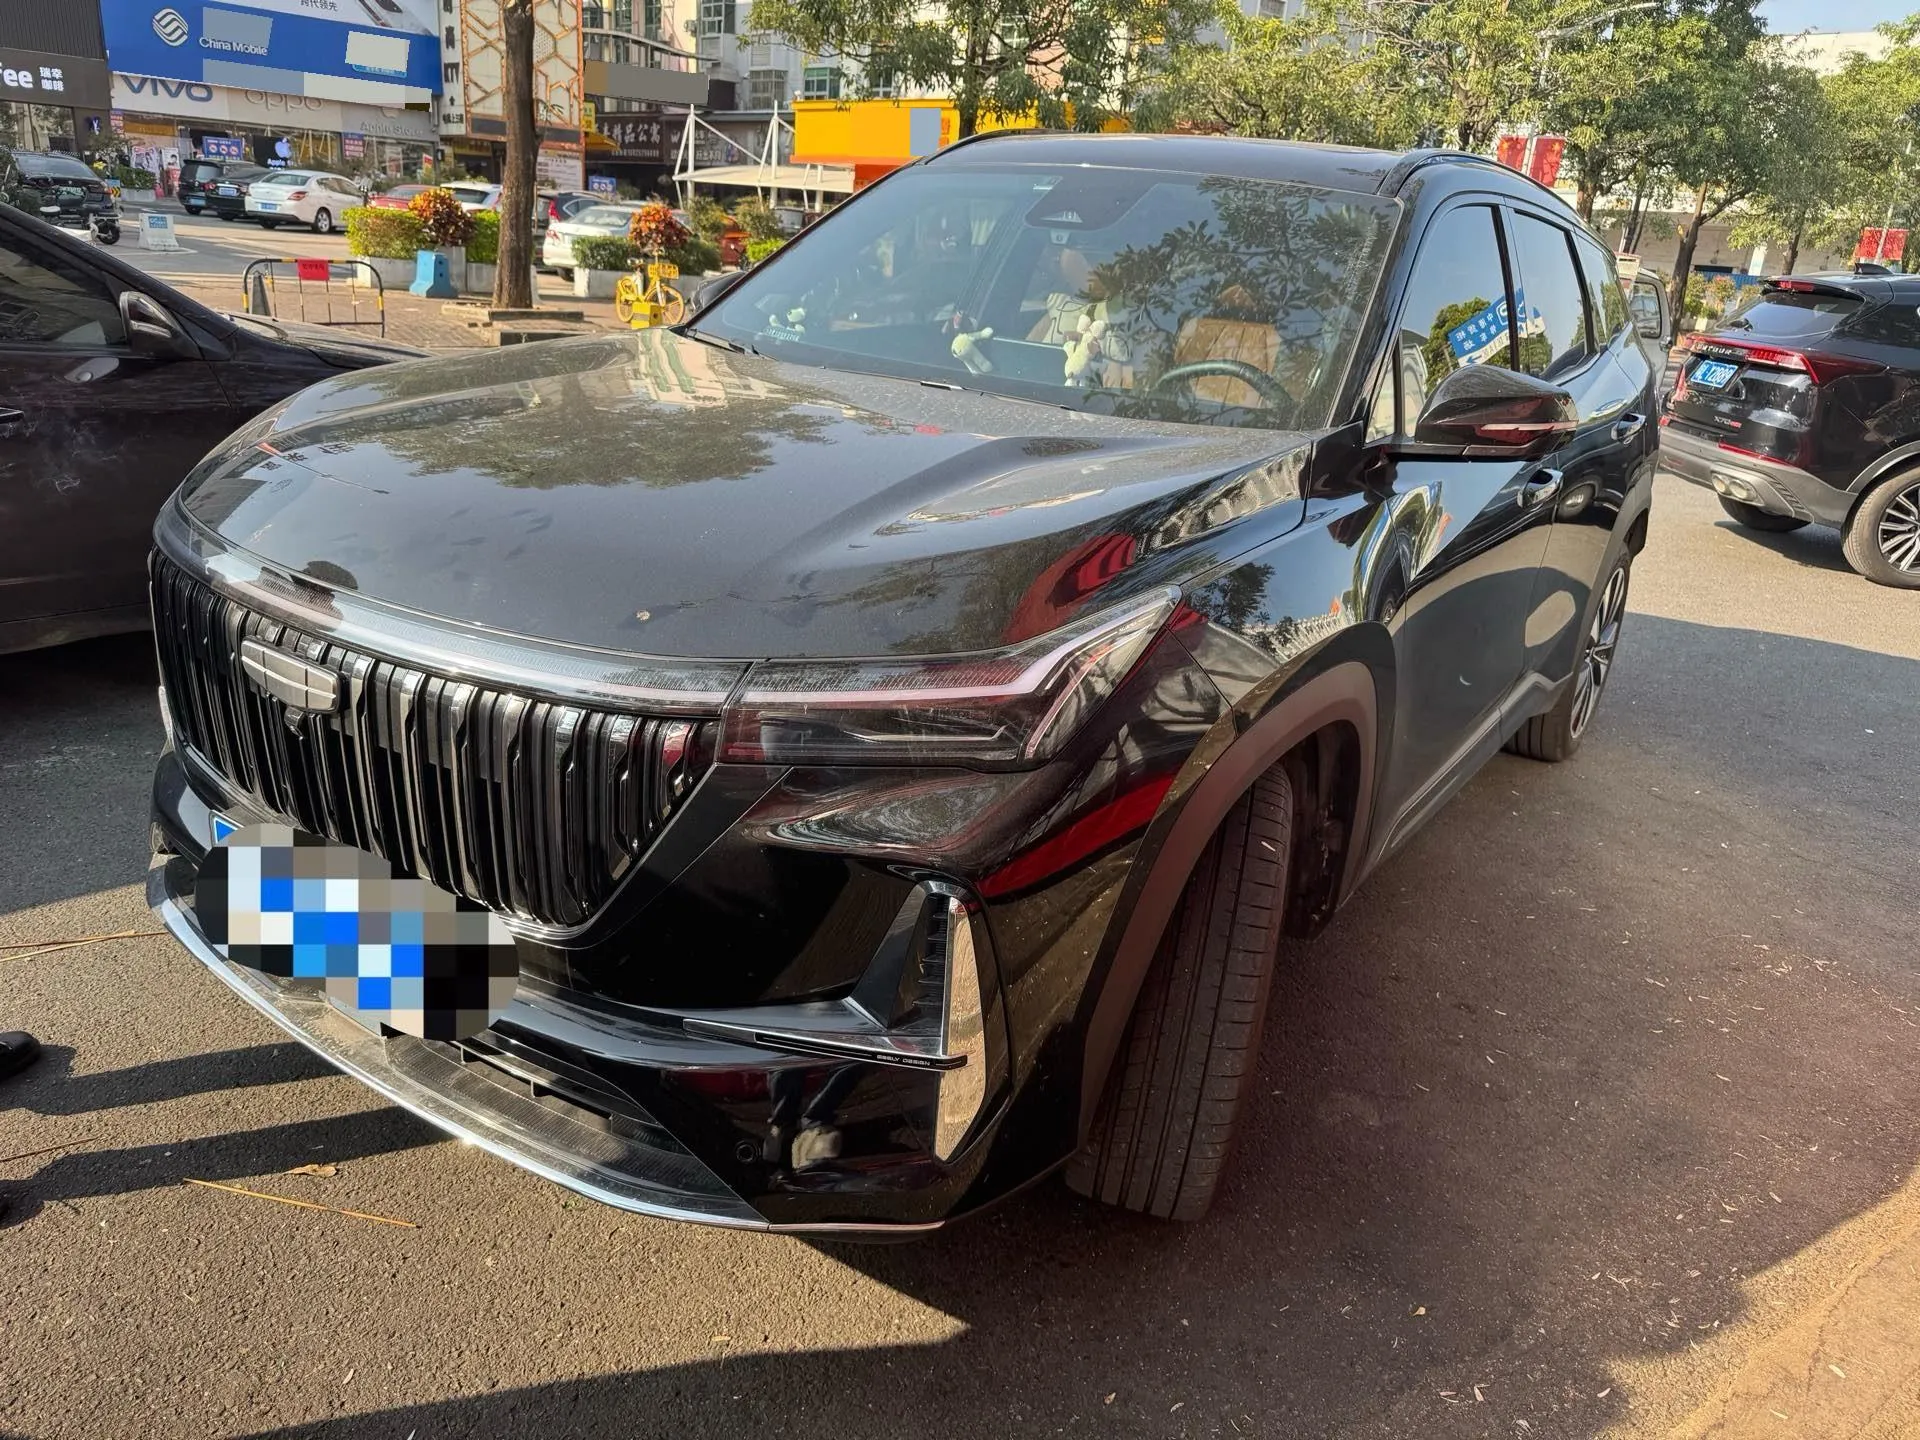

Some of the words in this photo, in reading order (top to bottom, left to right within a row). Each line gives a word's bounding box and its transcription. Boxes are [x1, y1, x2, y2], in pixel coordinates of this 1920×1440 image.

[199, 37, 231, 51] China
[232, 42, 268, 56] Mobile
[0, 62, 34, 88] ee
[41, 79, 64, 91] 咖啡
[876, 1054, 900, 1062] GEELY
[902, 1058, 930, 1066] DESIGN
